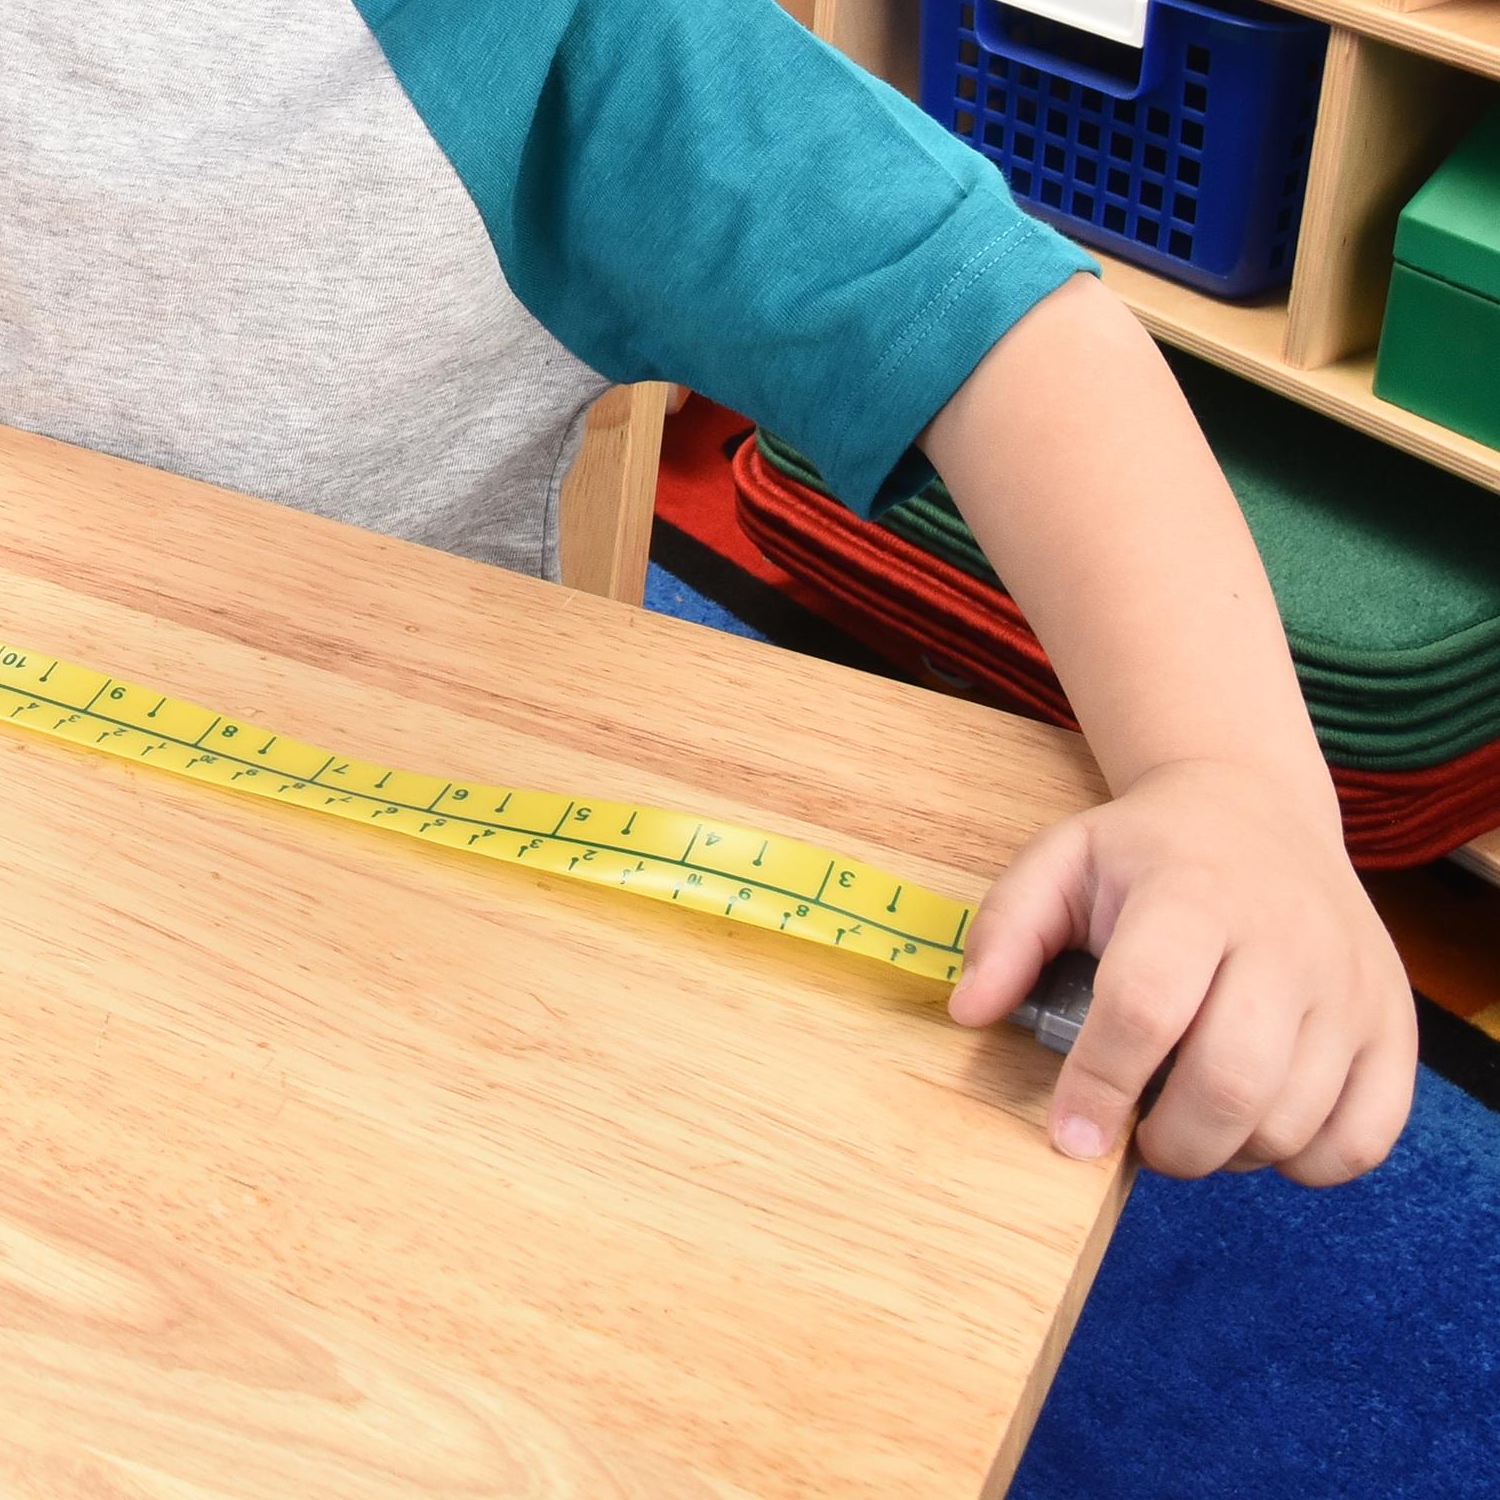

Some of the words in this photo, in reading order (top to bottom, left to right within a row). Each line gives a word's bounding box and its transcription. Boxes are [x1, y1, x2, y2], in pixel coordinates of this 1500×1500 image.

[2, 652, 28, 669] 10
[109, 687, 126, 700] 9
[221, 725, 238, 738] 8
[333, 763, 349, 774] 7
[452, 789, 468, 800] 6
[574, 807, 592, 821] 5
[705, 832, 722, 847] 4
[838, 871, 856, 888] 3
